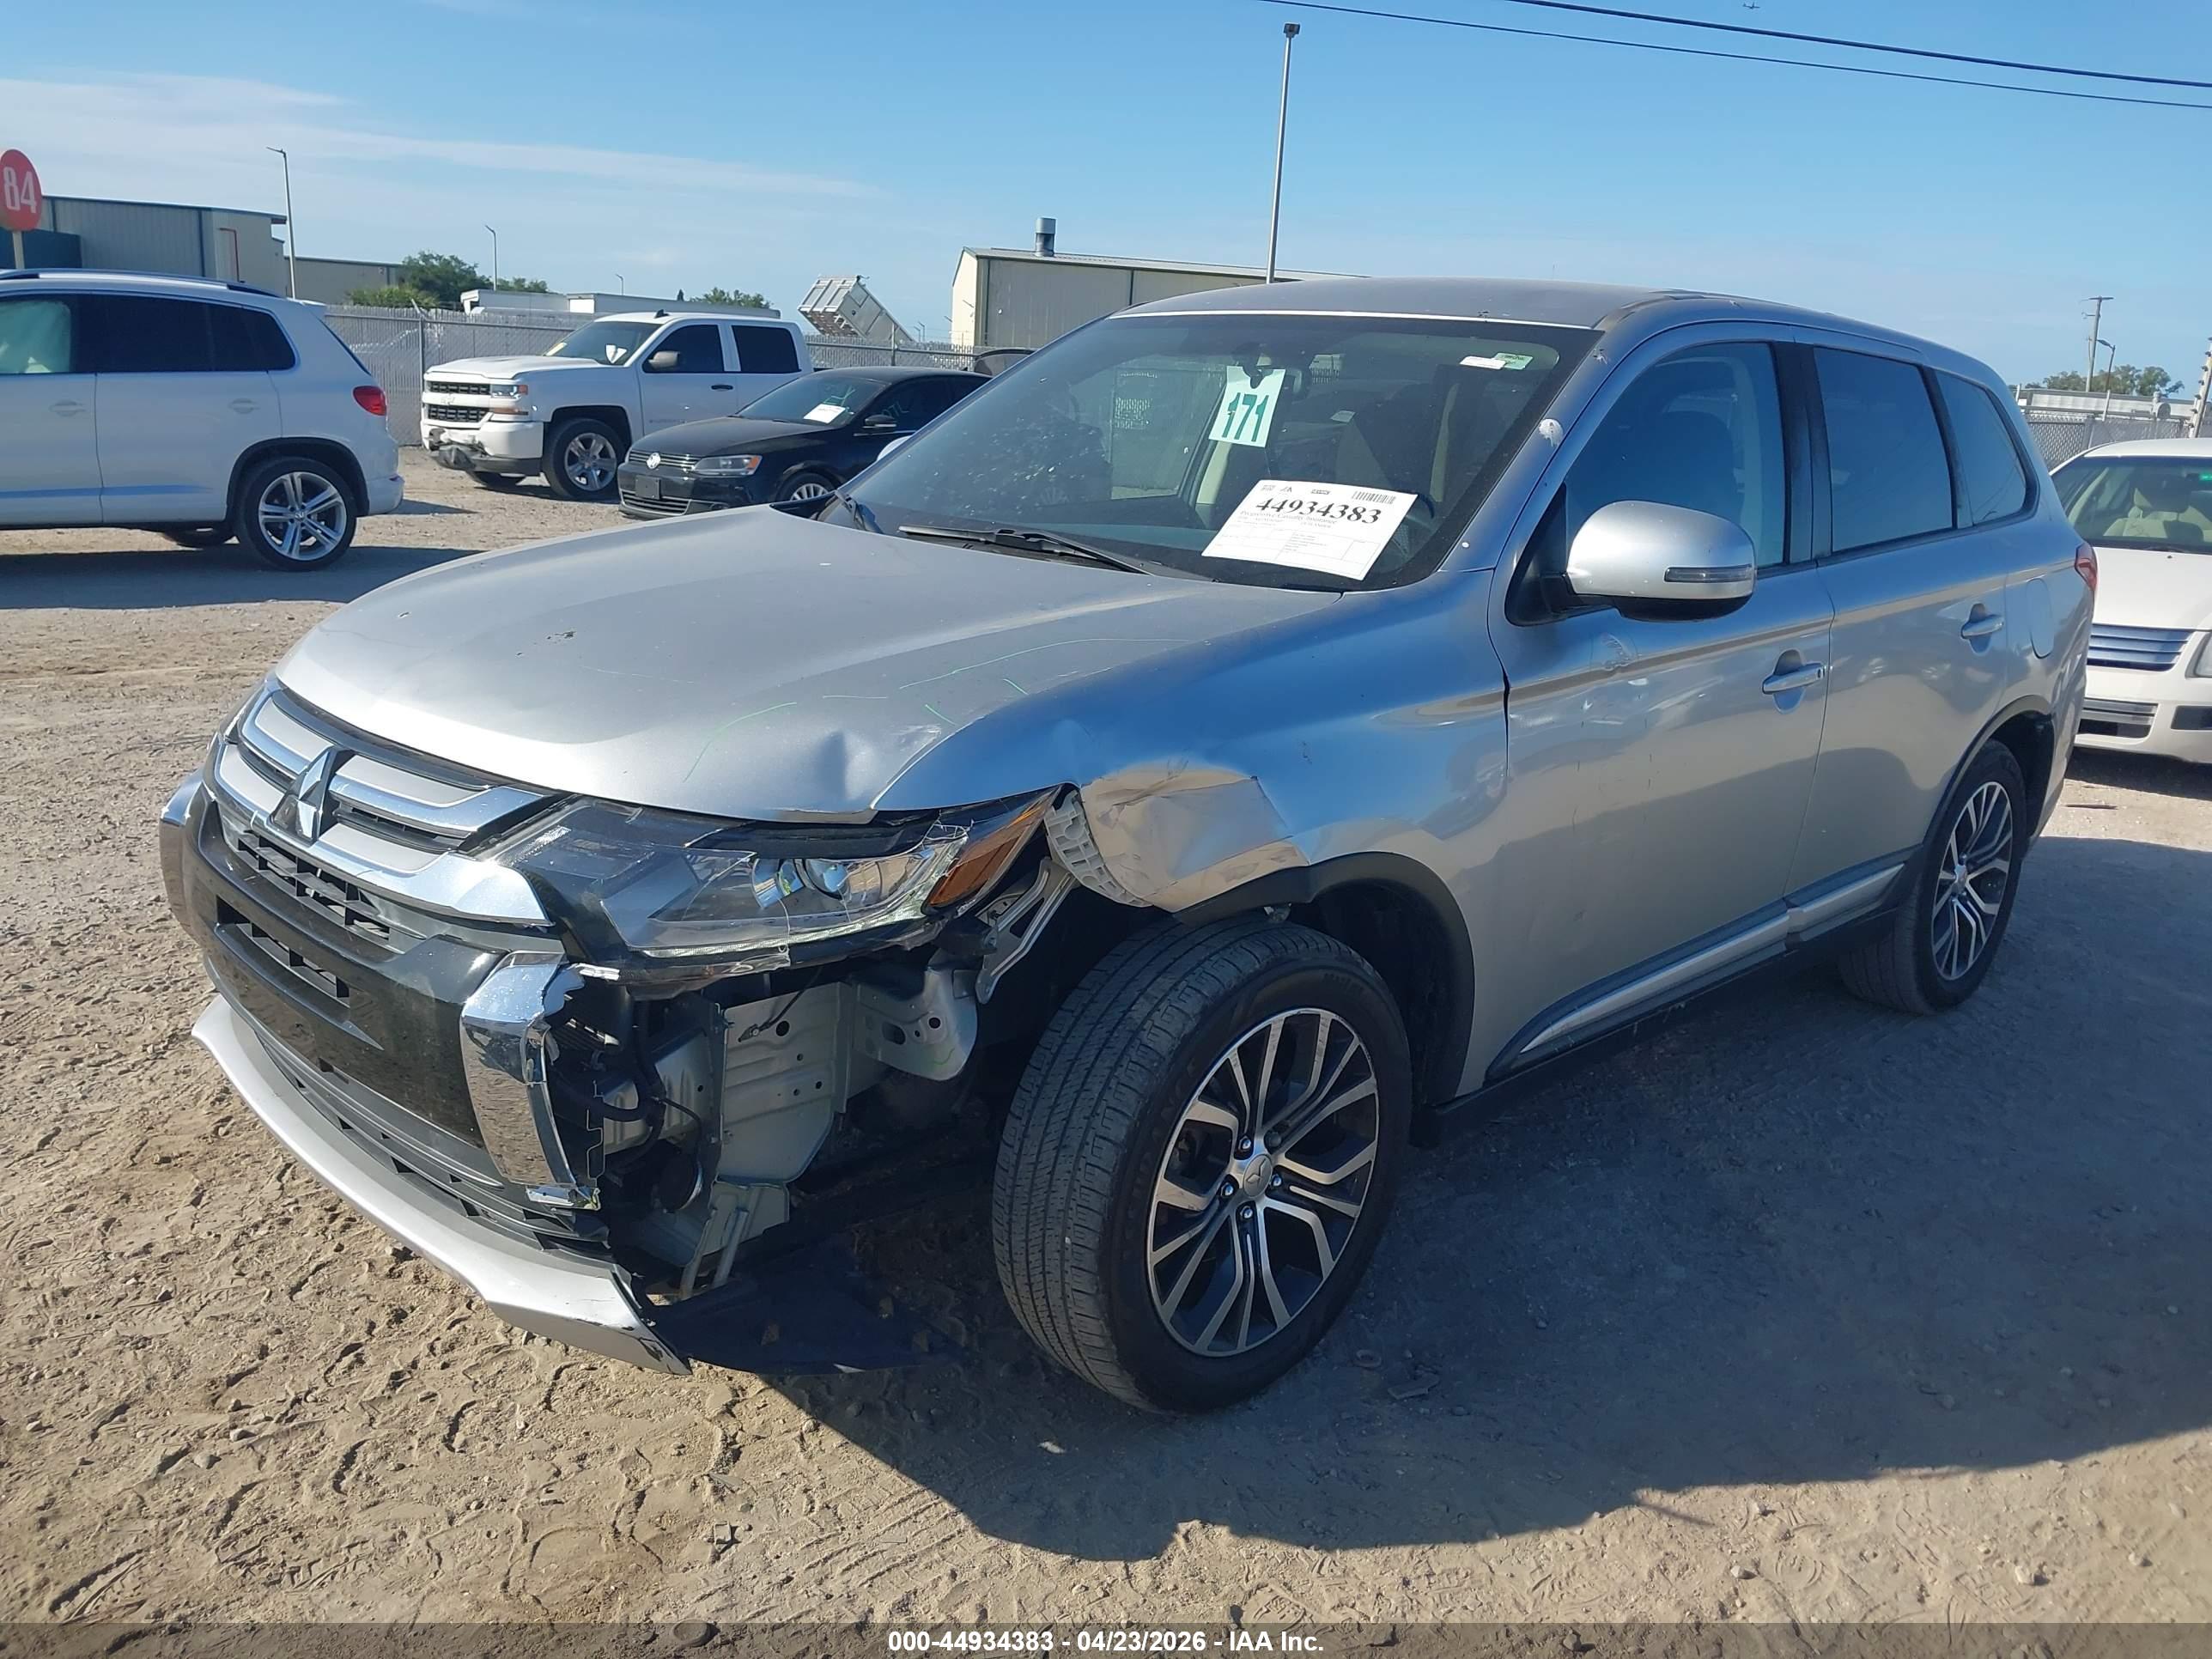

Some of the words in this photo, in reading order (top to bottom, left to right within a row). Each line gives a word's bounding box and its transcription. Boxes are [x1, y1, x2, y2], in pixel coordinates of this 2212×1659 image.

[3, 166, 37, 214] 84
[1221, 392, 1270, 442] 171
[1255, 497, 1382, 525] 44934383
